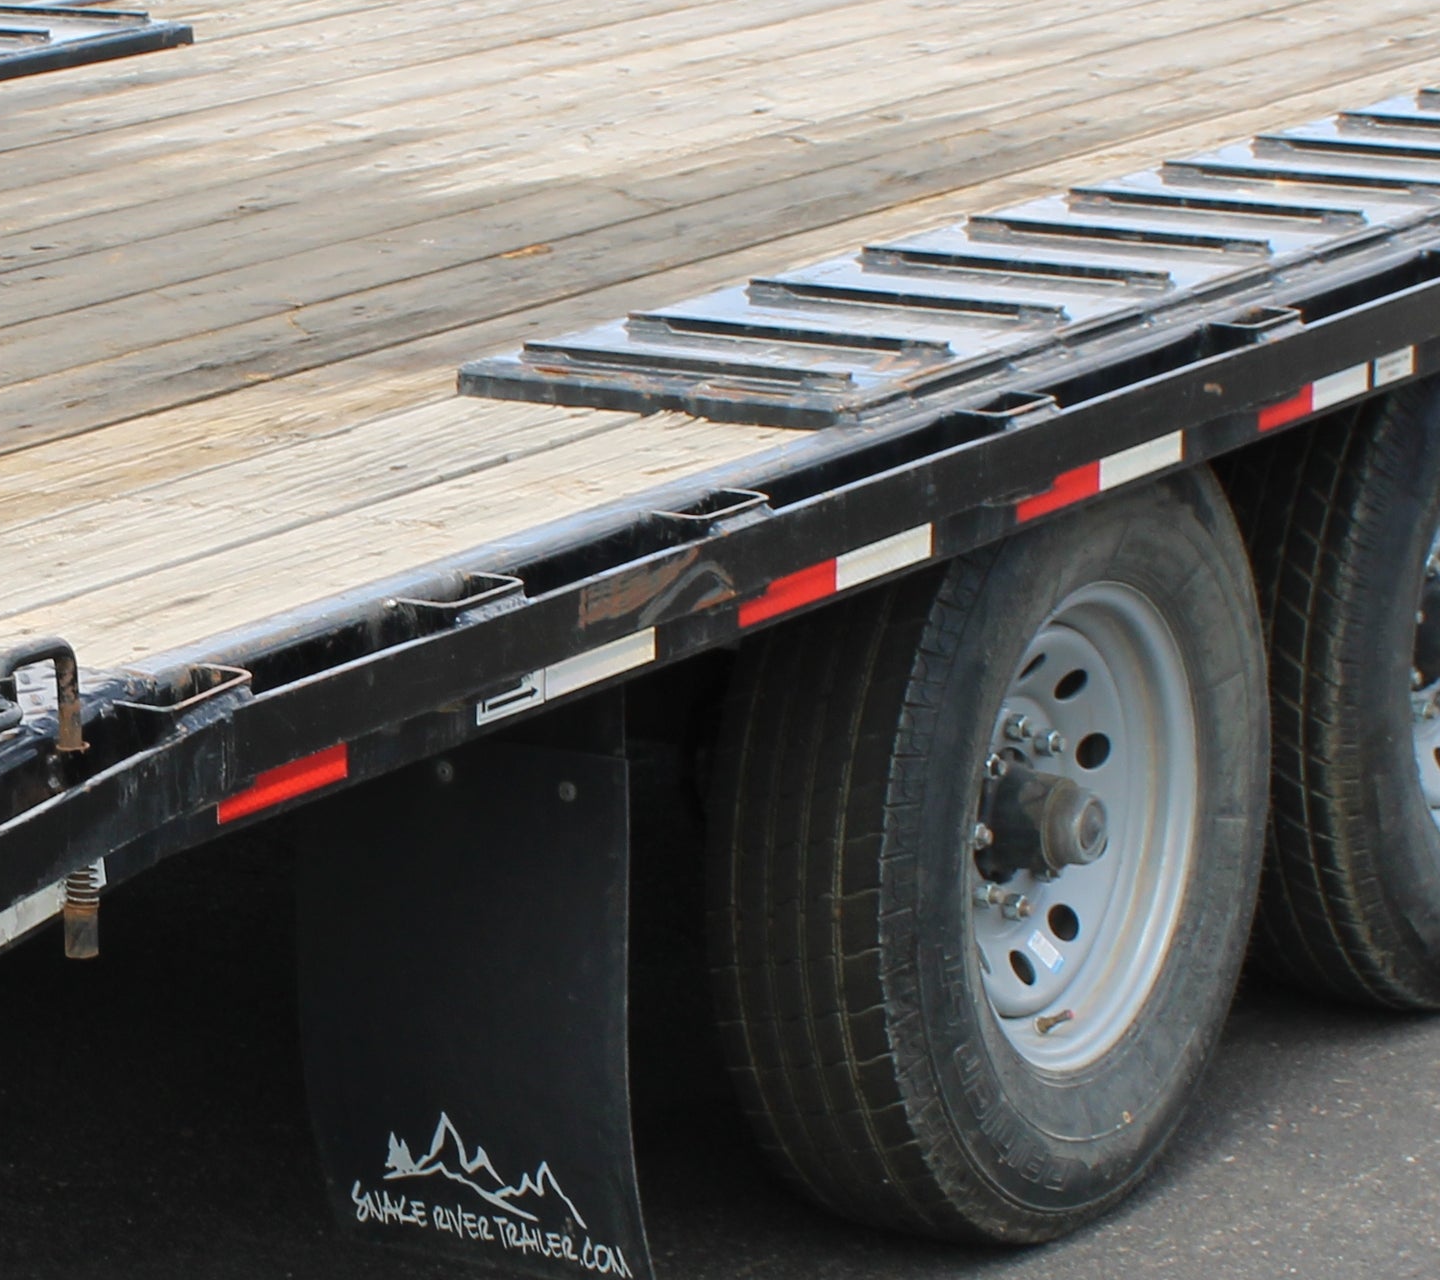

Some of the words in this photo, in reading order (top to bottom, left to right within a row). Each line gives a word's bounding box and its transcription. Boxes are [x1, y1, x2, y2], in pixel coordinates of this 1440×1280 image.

[350, 1179, 427, 1227] SNAKE
[432, 1204, 496, 1242] RIVER
[493, 1215, 634, 1280] TRAILER.COM
